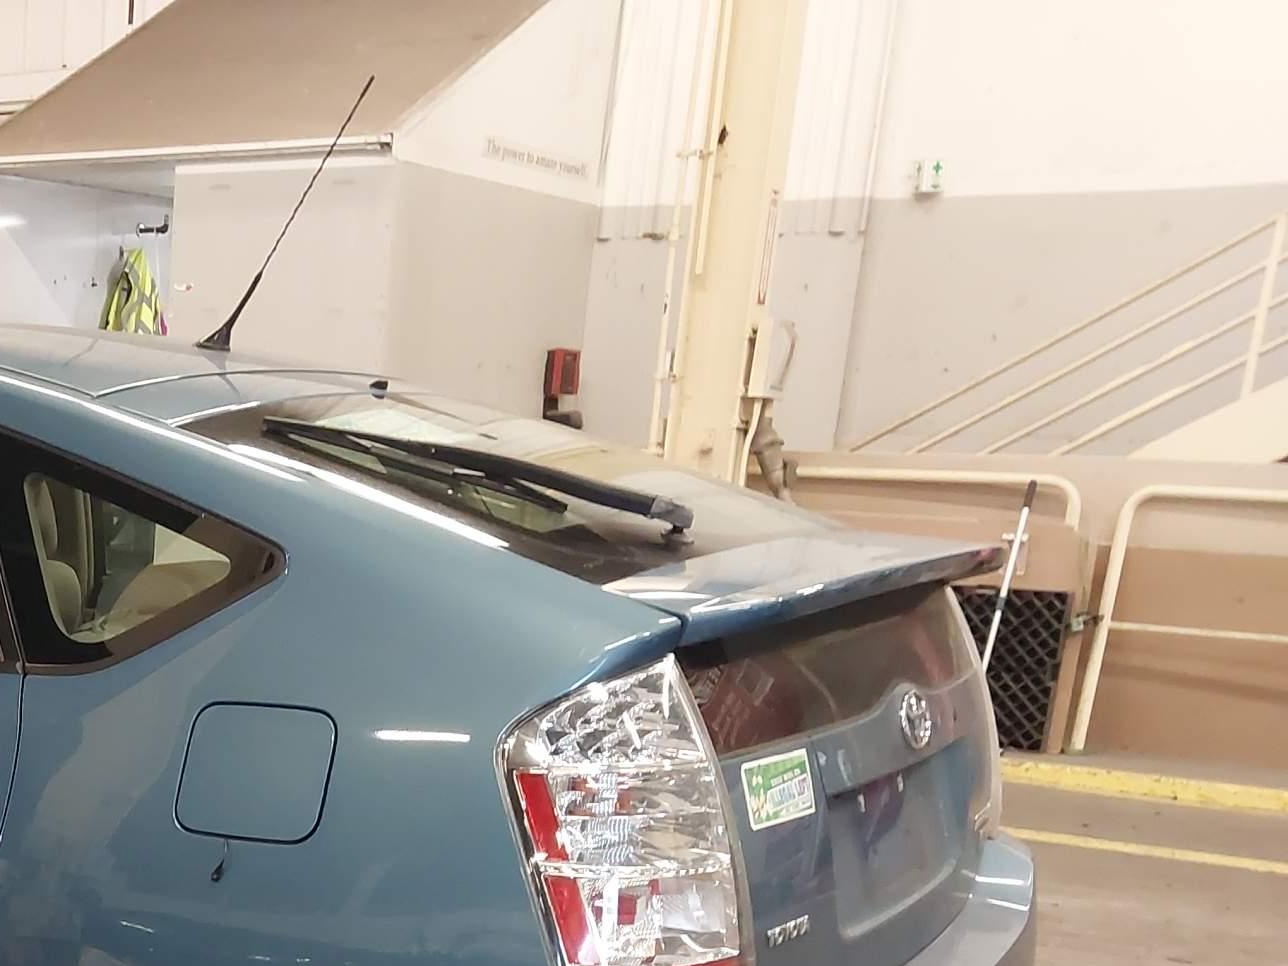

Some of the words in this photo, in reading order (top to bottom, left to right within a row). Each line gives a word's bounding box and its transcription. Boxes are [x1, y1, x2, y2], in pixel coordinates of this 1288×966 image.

[487, 138, 501, 154] The
[501, 146, 525, 162] power
[526, 150, 535, 164] to
[767, 914, 809, 948] TOYOTA
